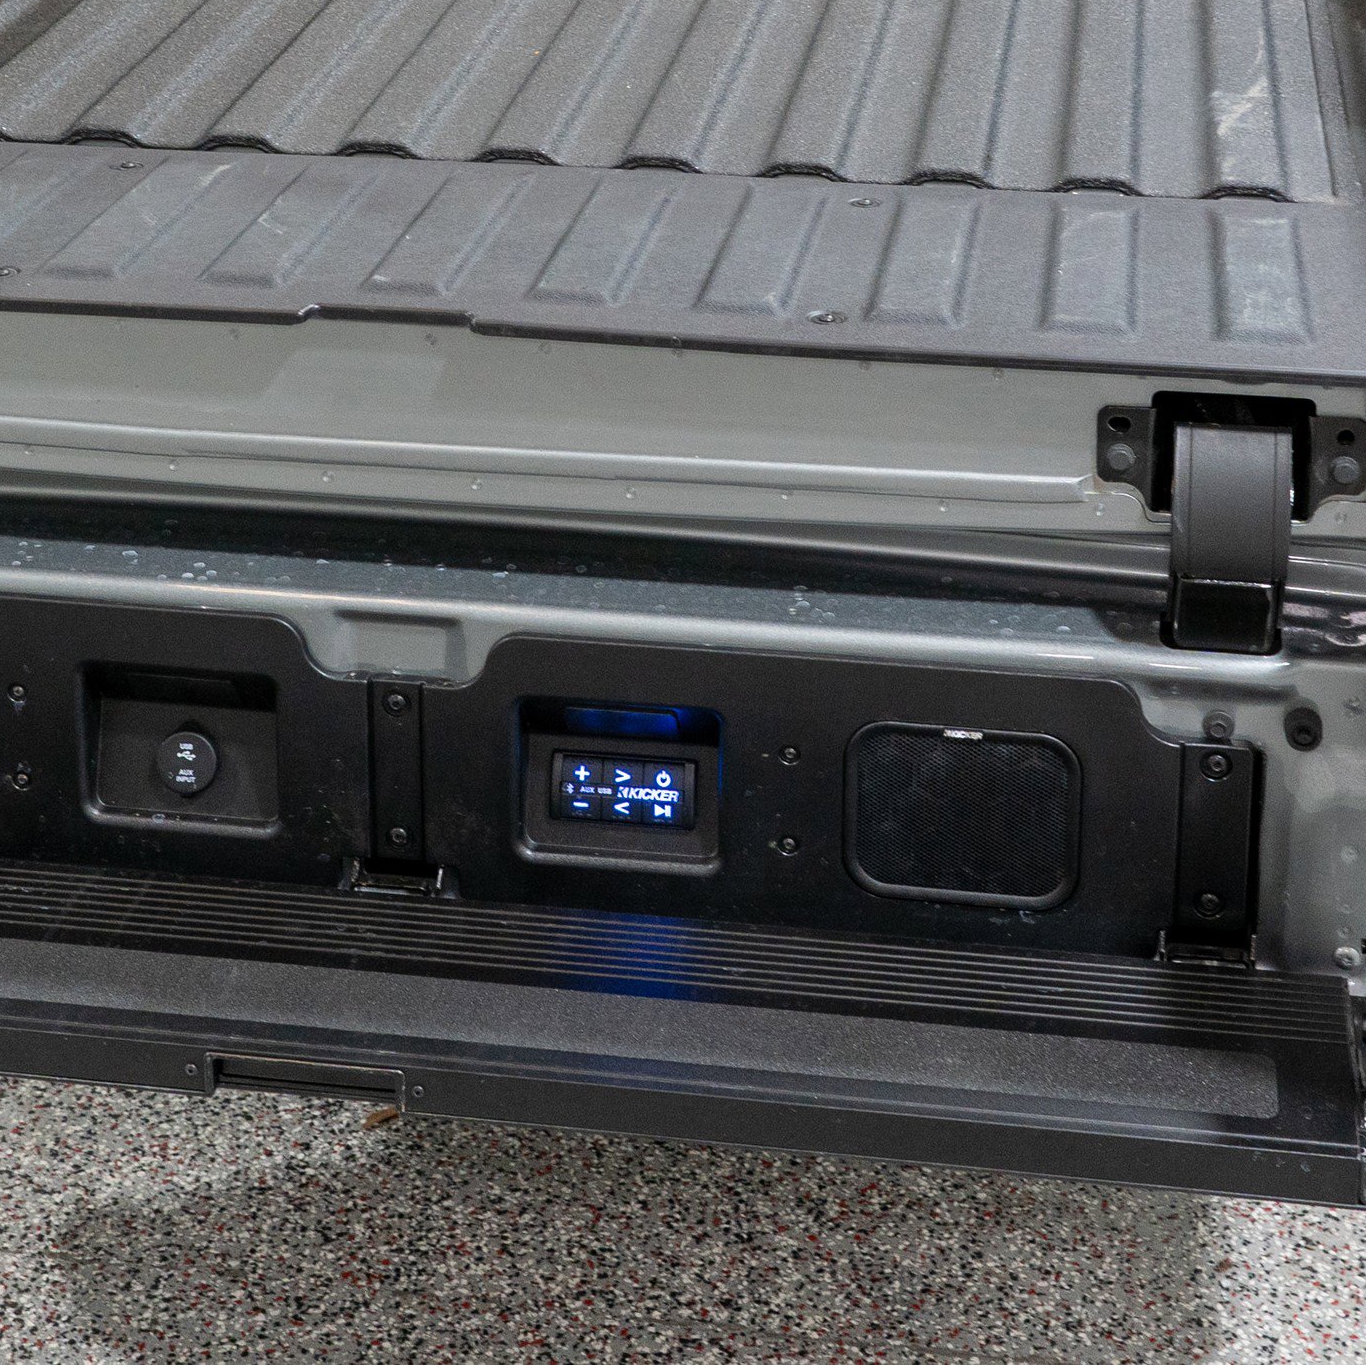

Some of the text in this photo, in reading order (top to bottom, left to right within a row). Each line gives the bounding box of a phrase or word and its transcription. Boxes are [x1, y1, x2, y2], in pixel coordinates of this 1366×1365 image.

[178, 768, 194, 776] AUX
[175, 775, 196, 783] INPUT
[579, 785, 680, 803] AUX USB KICKER
